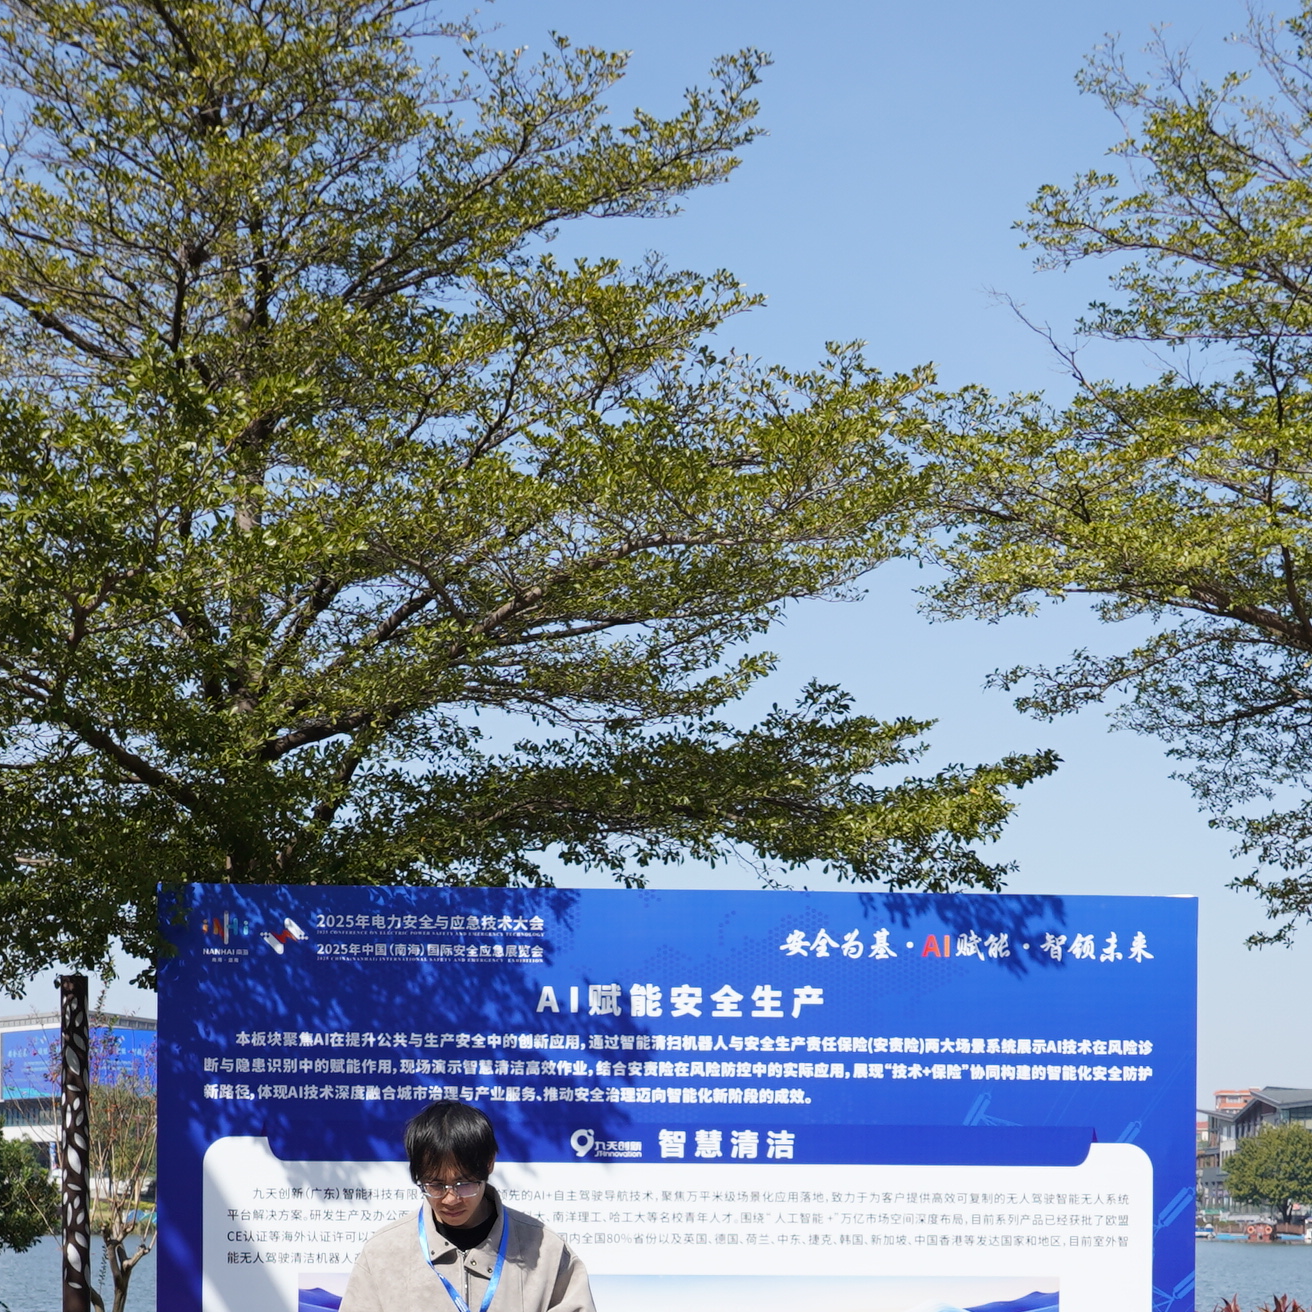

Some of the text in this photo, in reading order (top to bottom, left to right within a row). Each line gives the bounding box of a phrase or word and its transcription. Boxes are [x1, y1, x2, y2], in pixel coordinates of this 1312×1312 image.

[316, 913, 545, 931] 2025年电力安全与应急技术大会
[535, 982, 825, 1019] AI赋能安全生产
[658, 1129, 795, 1159] 智慧清洁
[227, 1230, 376, 1243] CE认证等海外认证许可以
